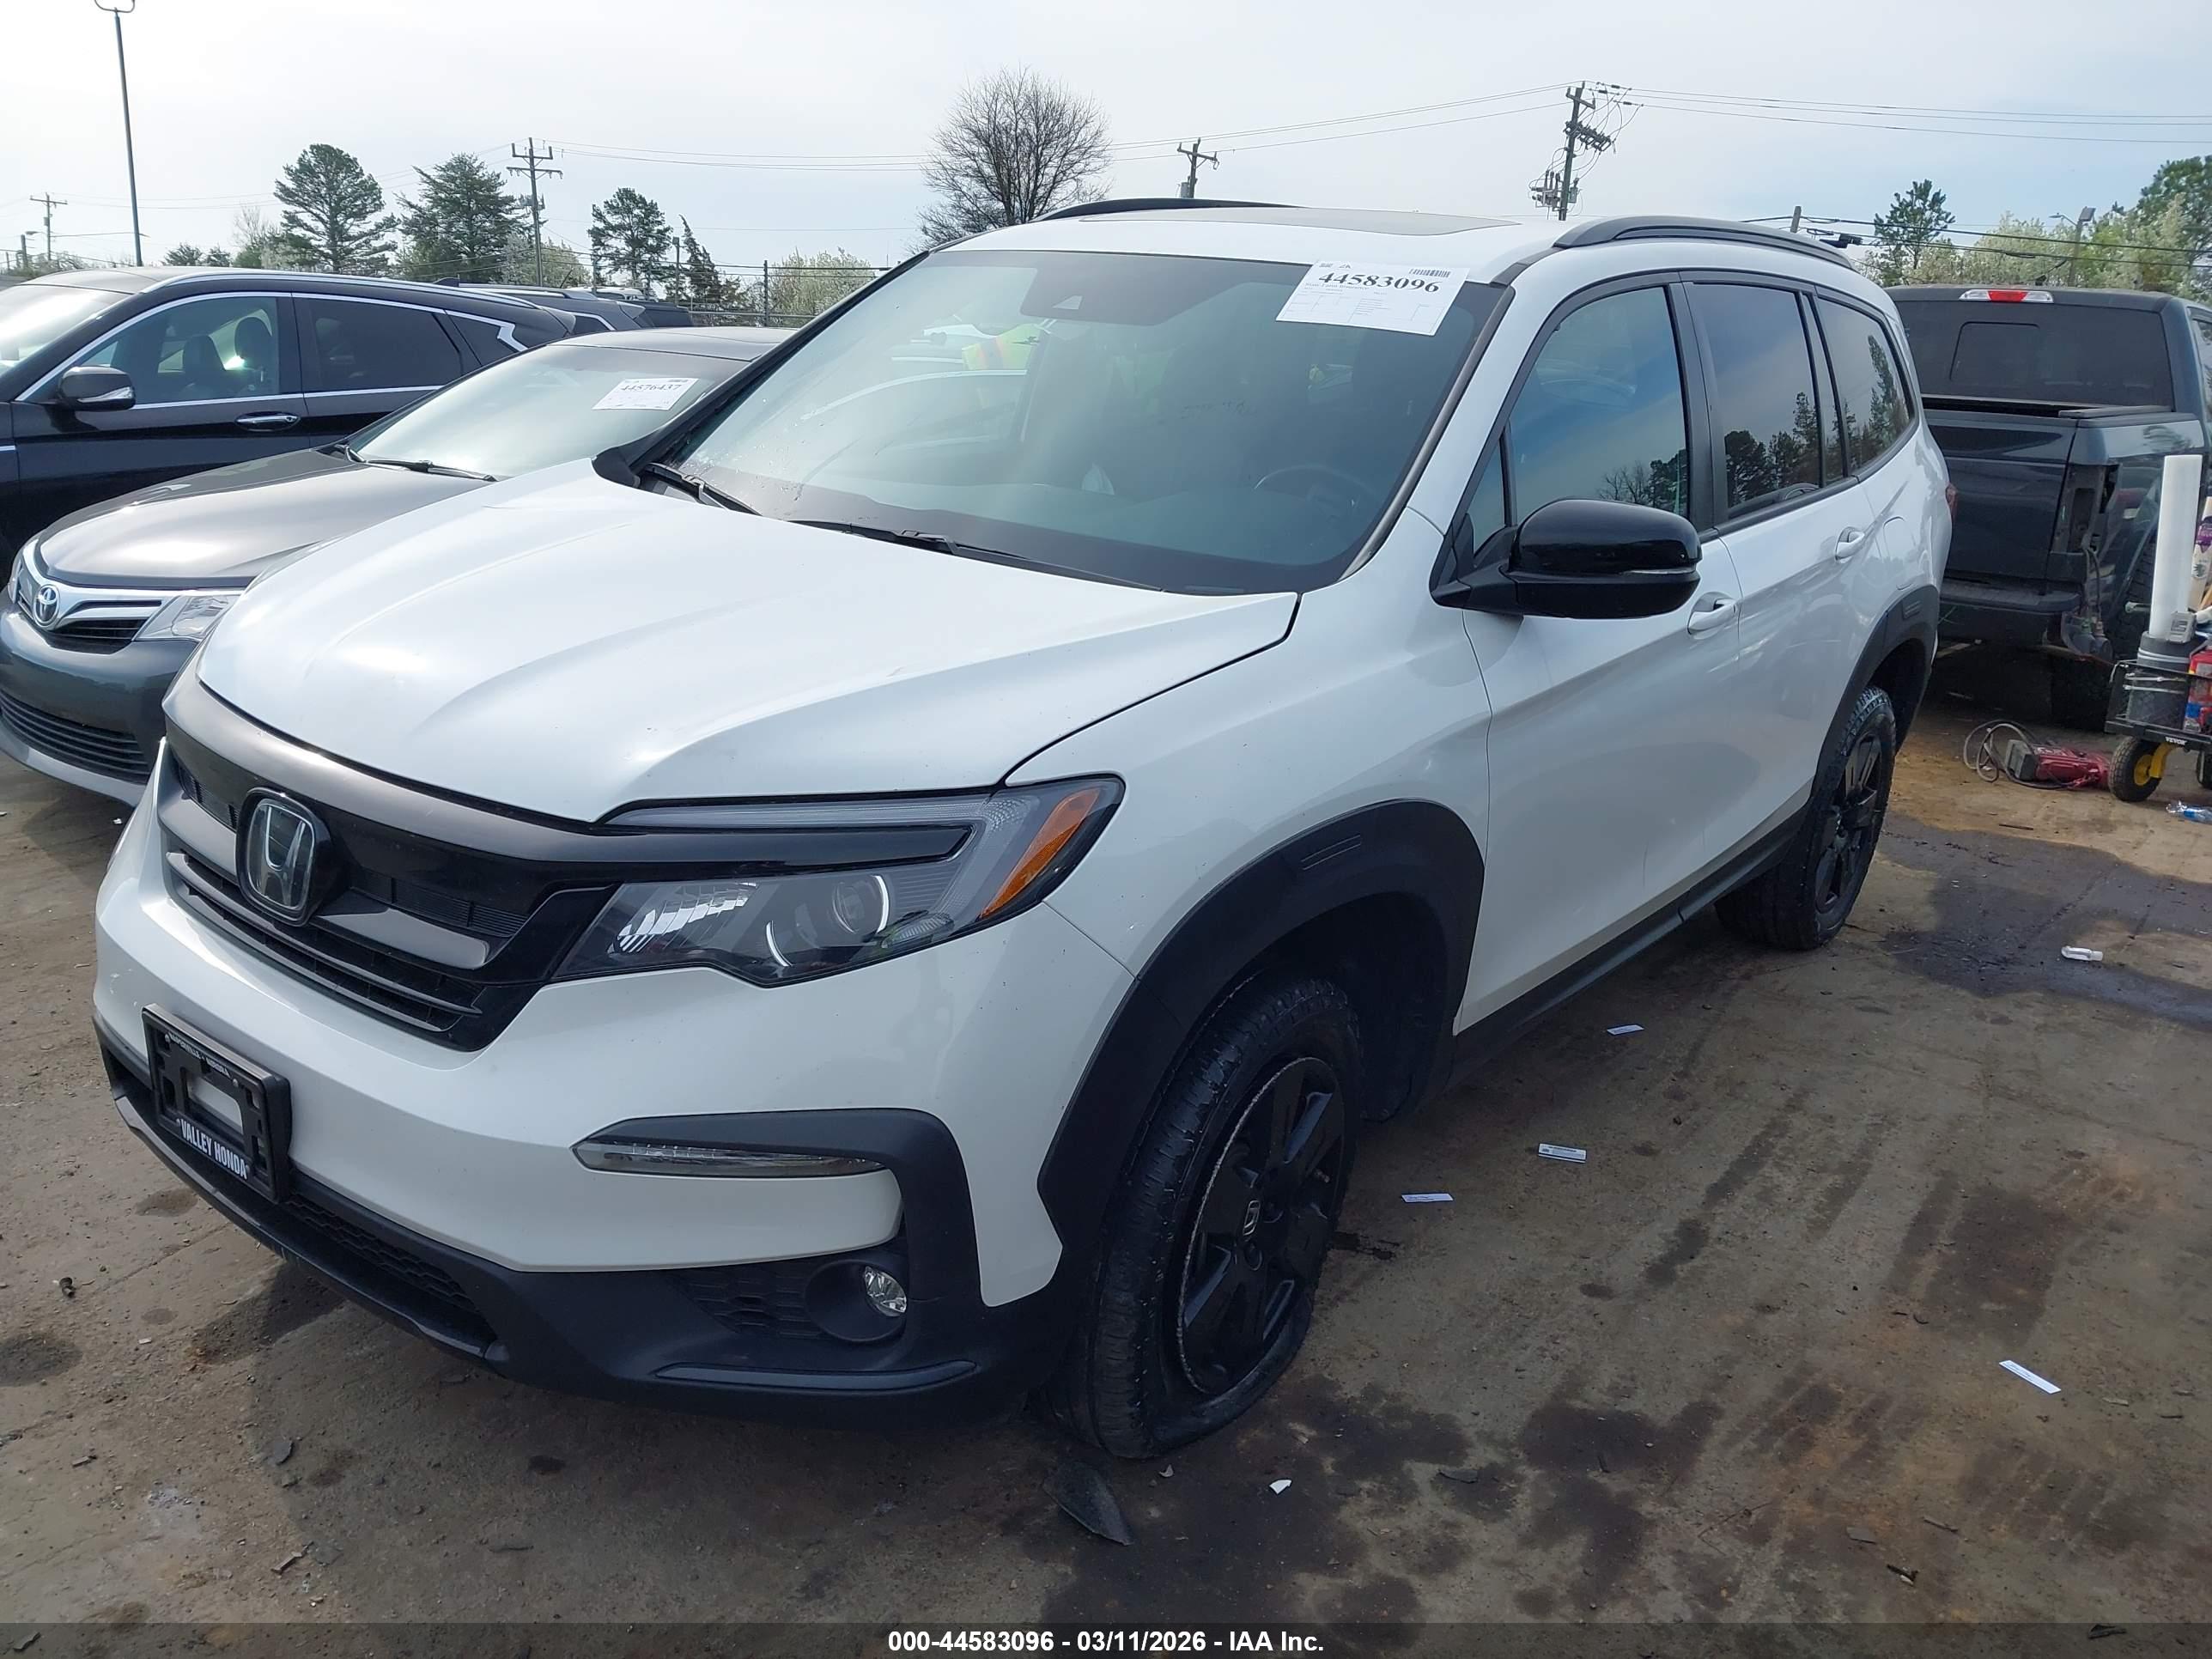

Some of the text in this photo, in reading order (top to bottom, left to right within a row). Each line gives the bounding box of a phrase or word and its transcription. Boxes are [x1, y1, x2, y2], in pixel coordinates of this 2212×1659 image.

[1319, 272, 1442, 293] 44583096
[180, 1119, 247, 1180] VALLEY HONDA
